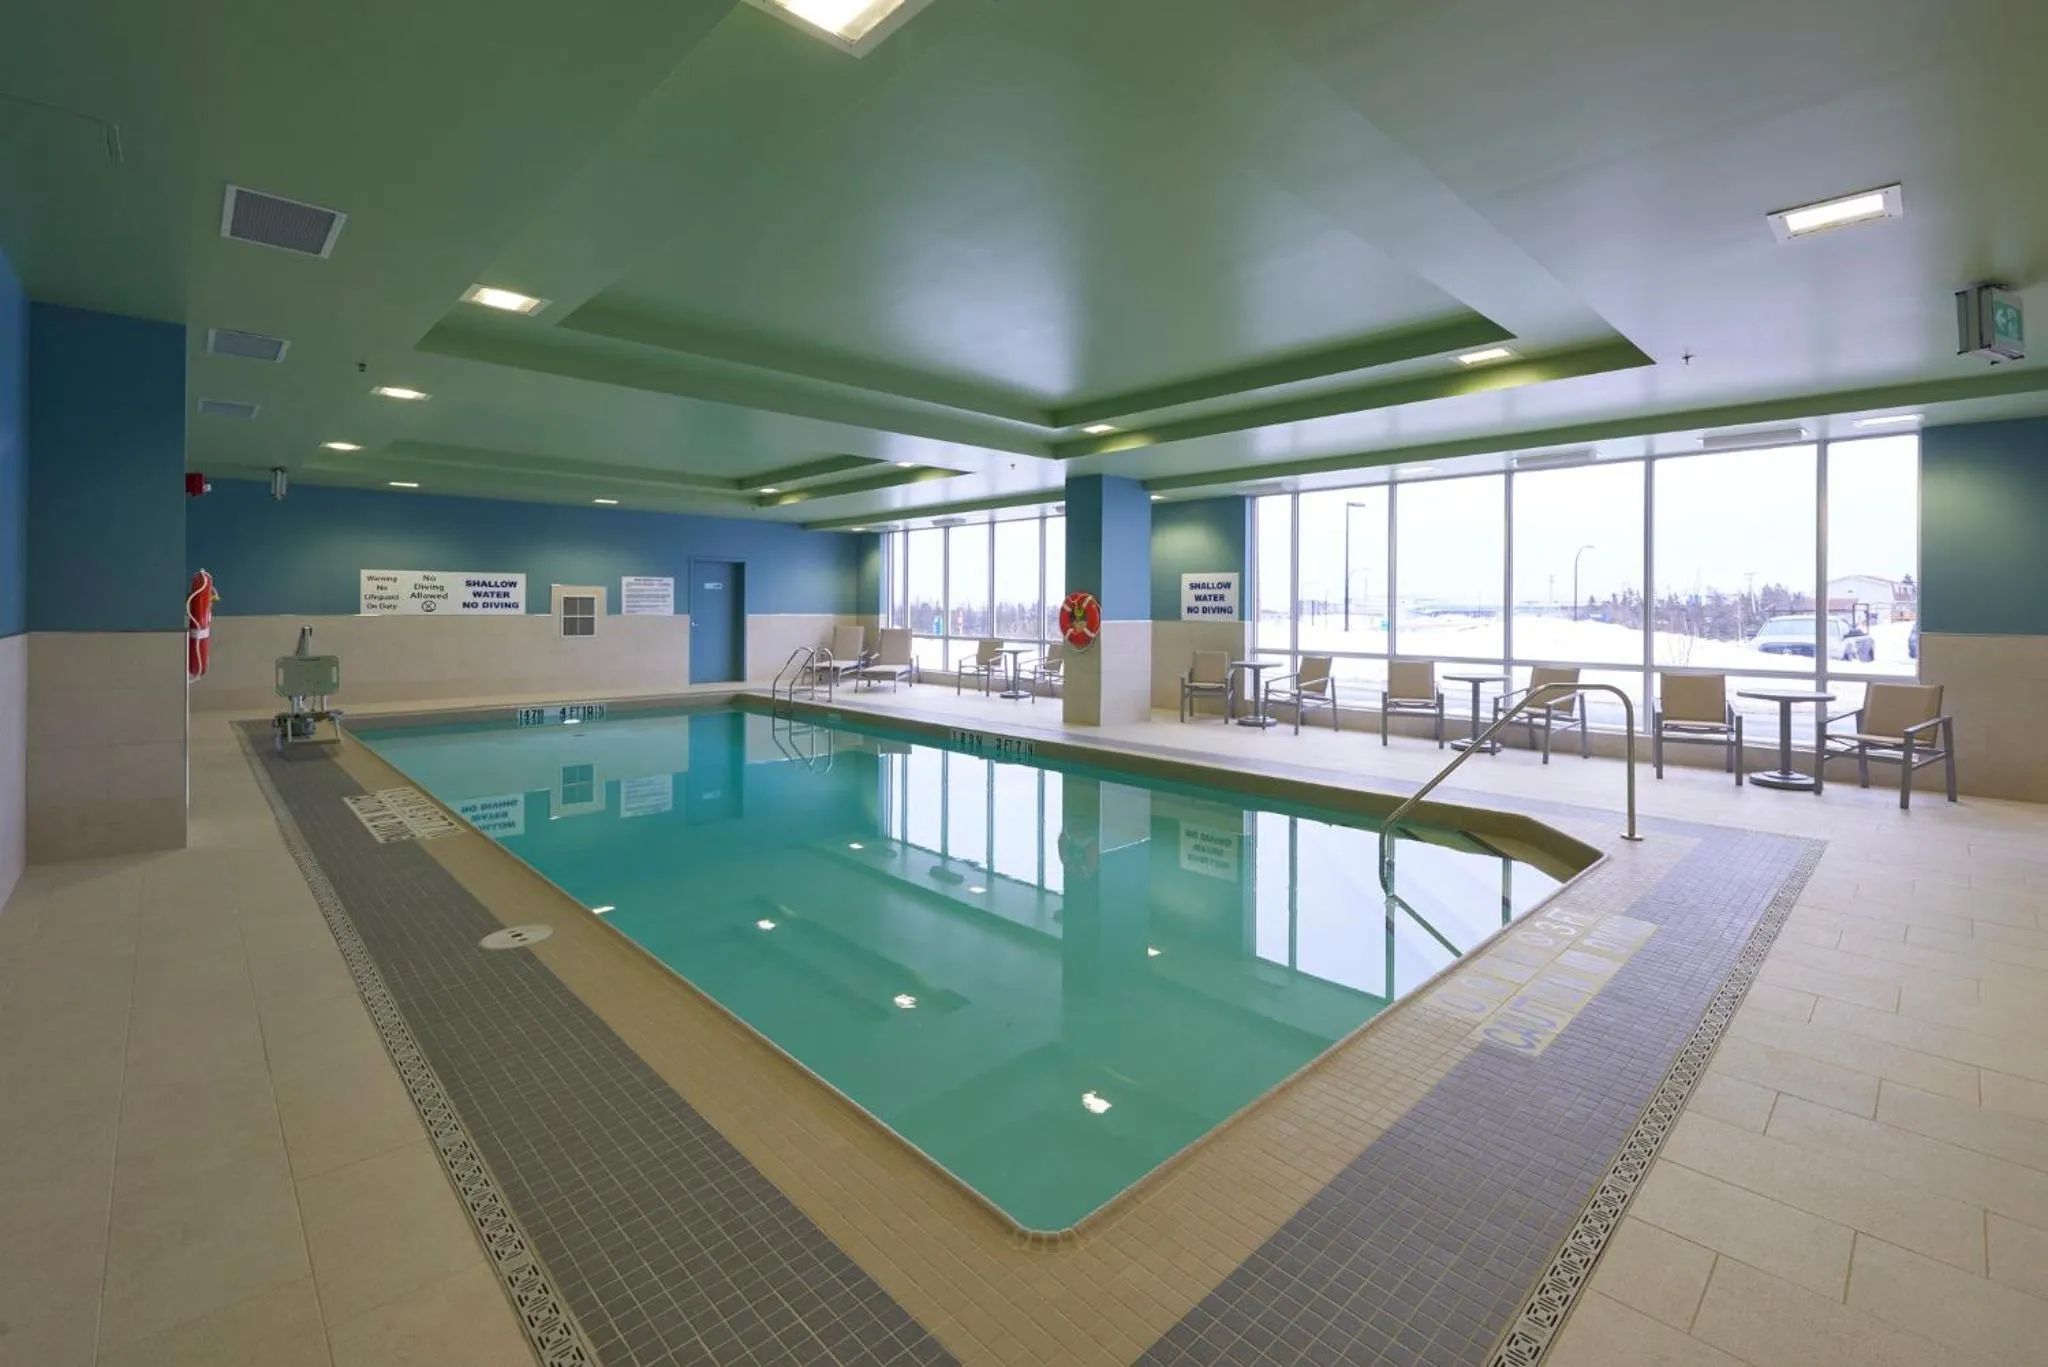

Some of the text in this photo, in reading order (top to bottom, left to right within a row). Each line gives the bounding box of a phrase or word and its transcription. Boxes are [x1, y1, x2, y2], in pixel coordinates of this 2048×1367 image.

[366, 575, 398, 583] Warning
[423, 574, 436, 582] No
[414, 583, 445, 591] Diving
[465, 579, 518, 588] SHALLOW
[1188, 581, 1232, 590] SHALLOW
[410, 592, 449, 600] Allowed
[472, 590, 511, 598] WATER
[1194, 593, 1226, 602] WATER
[462, 601, 519, 609] NO DIVING
[1186, 605, 1233, 614] NO DIVING
